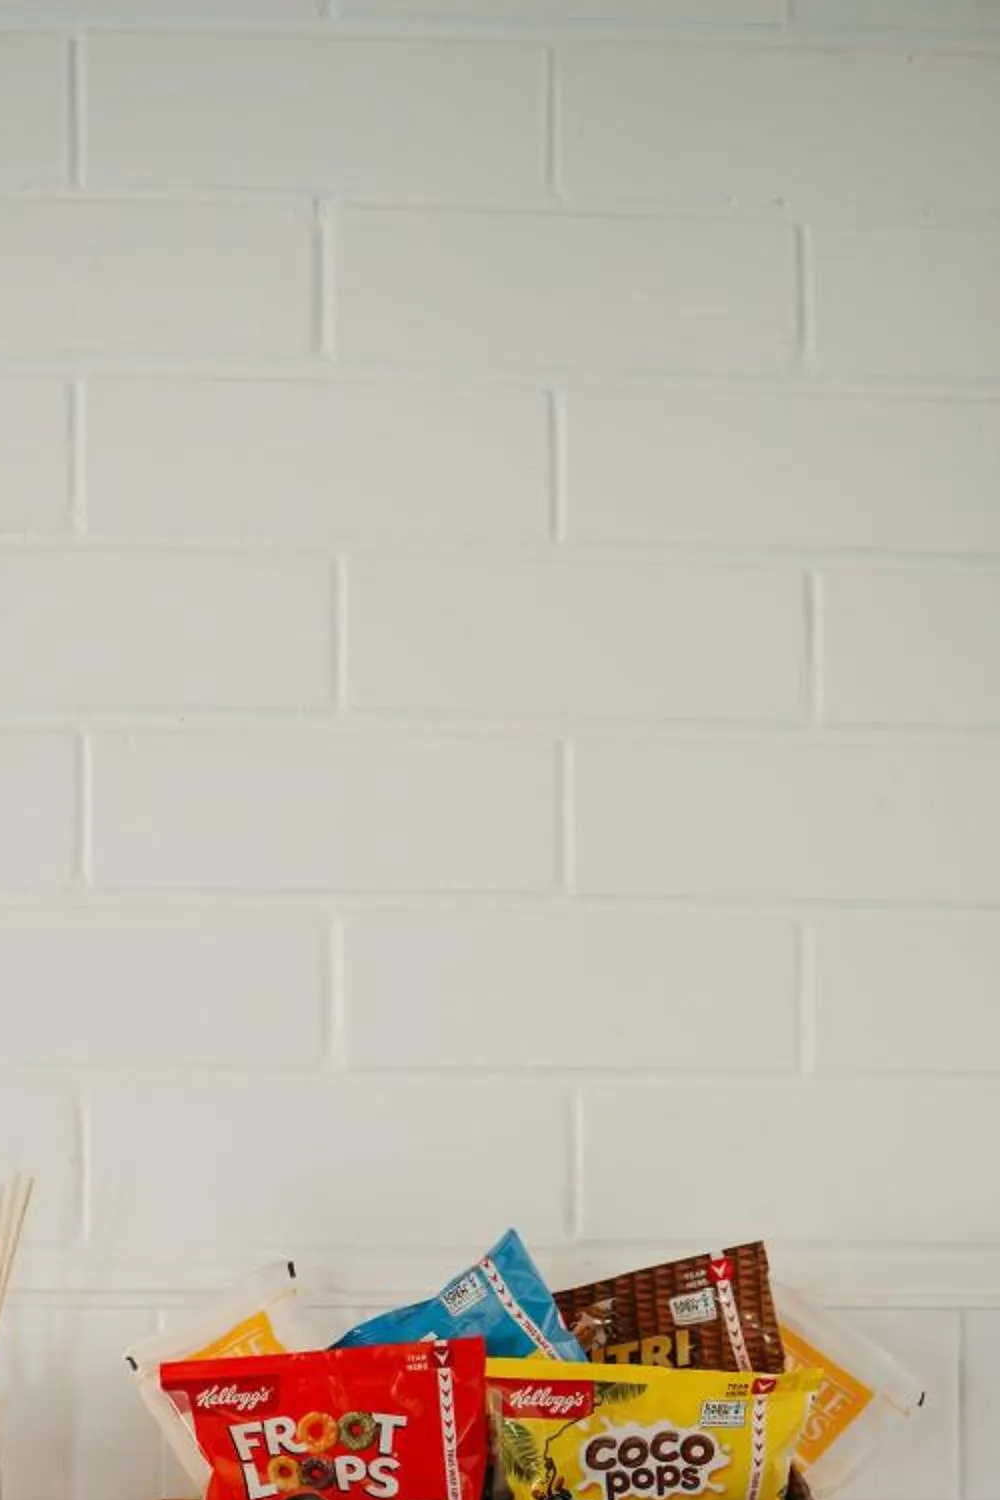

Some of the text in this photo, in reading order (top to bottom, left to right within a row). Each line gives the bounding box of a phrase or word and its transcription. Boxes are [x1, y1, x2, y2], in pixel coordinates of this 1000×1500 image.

[592, 1329, 692, 1368] TRI
[197, 1384, 273, 1411] Kellogg's
[509, 1385, 586, 1414] Kellogg's
[229, 1410, 408, 1461] FROOT
[243, 1454, 402, 1500] LOOPS
